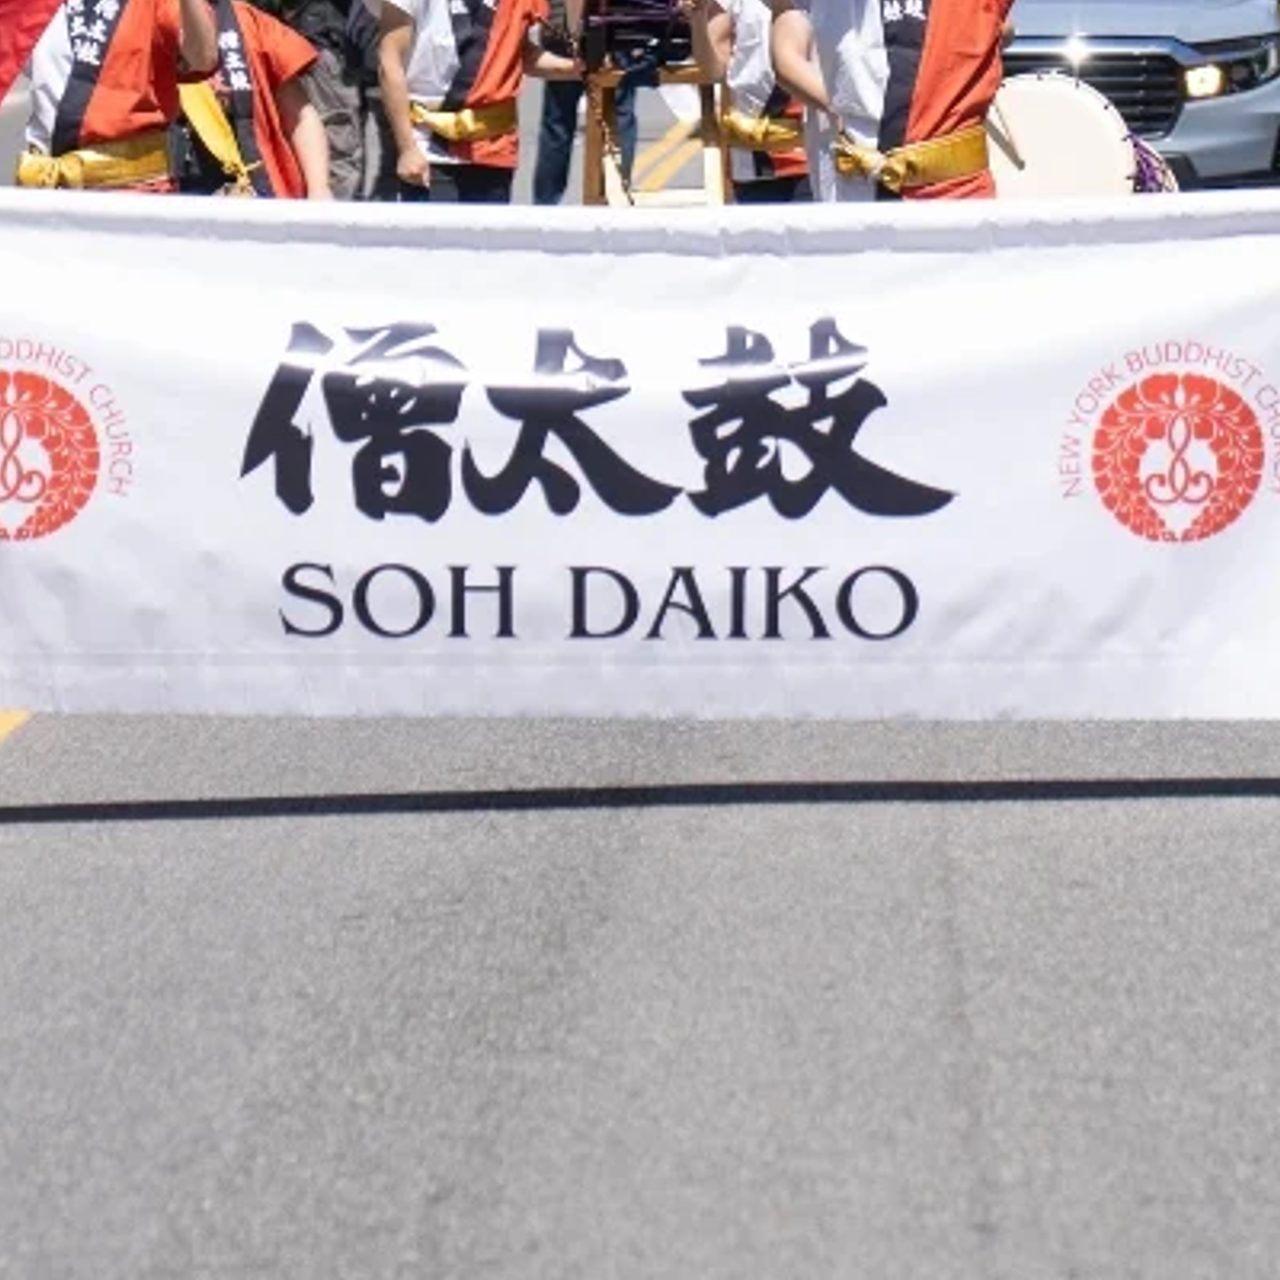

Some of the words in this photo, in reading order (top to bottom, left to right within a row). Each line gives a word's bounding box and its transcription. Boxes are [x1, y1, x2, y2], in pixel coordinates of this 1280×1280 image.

[1068, 363, 1122, 429] YORK
[1122, 340, 1263, 387] BUDDHIST
[88, 382, 134, 497] CHURCH
[239, 317, 960, 524] 僧太鼓
[1058, 434, 1081, 500] NEW
[277, 562, 517, 640] SOH
[566, 564, 921, 641] DAIKO
